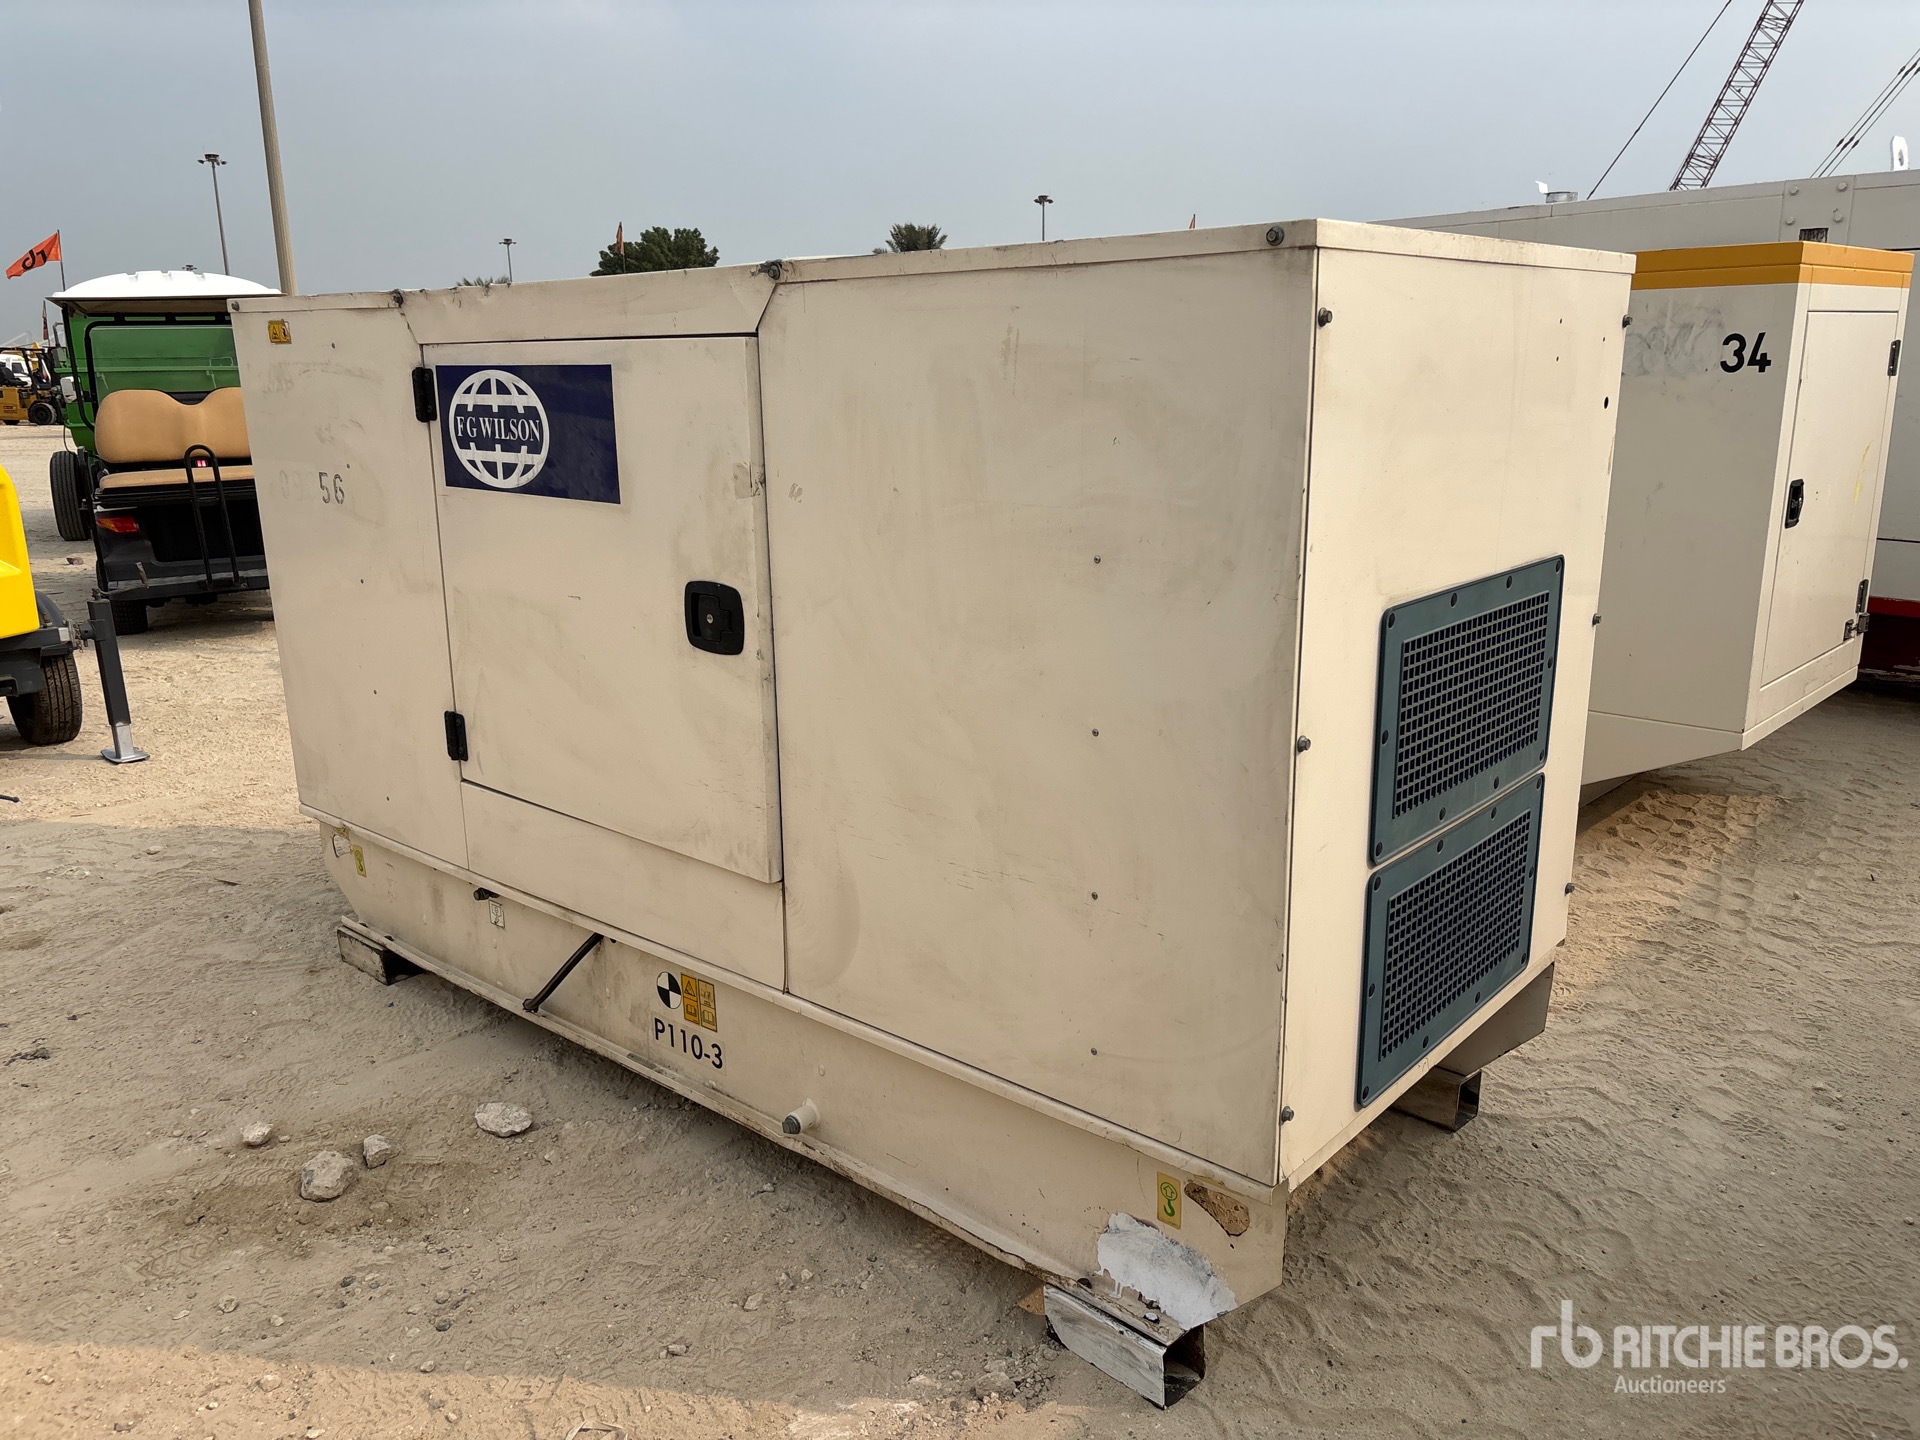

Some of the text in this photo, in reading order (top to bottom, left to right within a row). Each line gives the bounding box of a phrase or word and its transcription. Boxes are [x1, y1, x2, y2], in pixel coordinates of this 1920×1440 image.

[1720, 332, 1772, 373] 34
[456, 416, 541, 442] FG WILSON
[654, 1017, 723, 1069] P110-3
